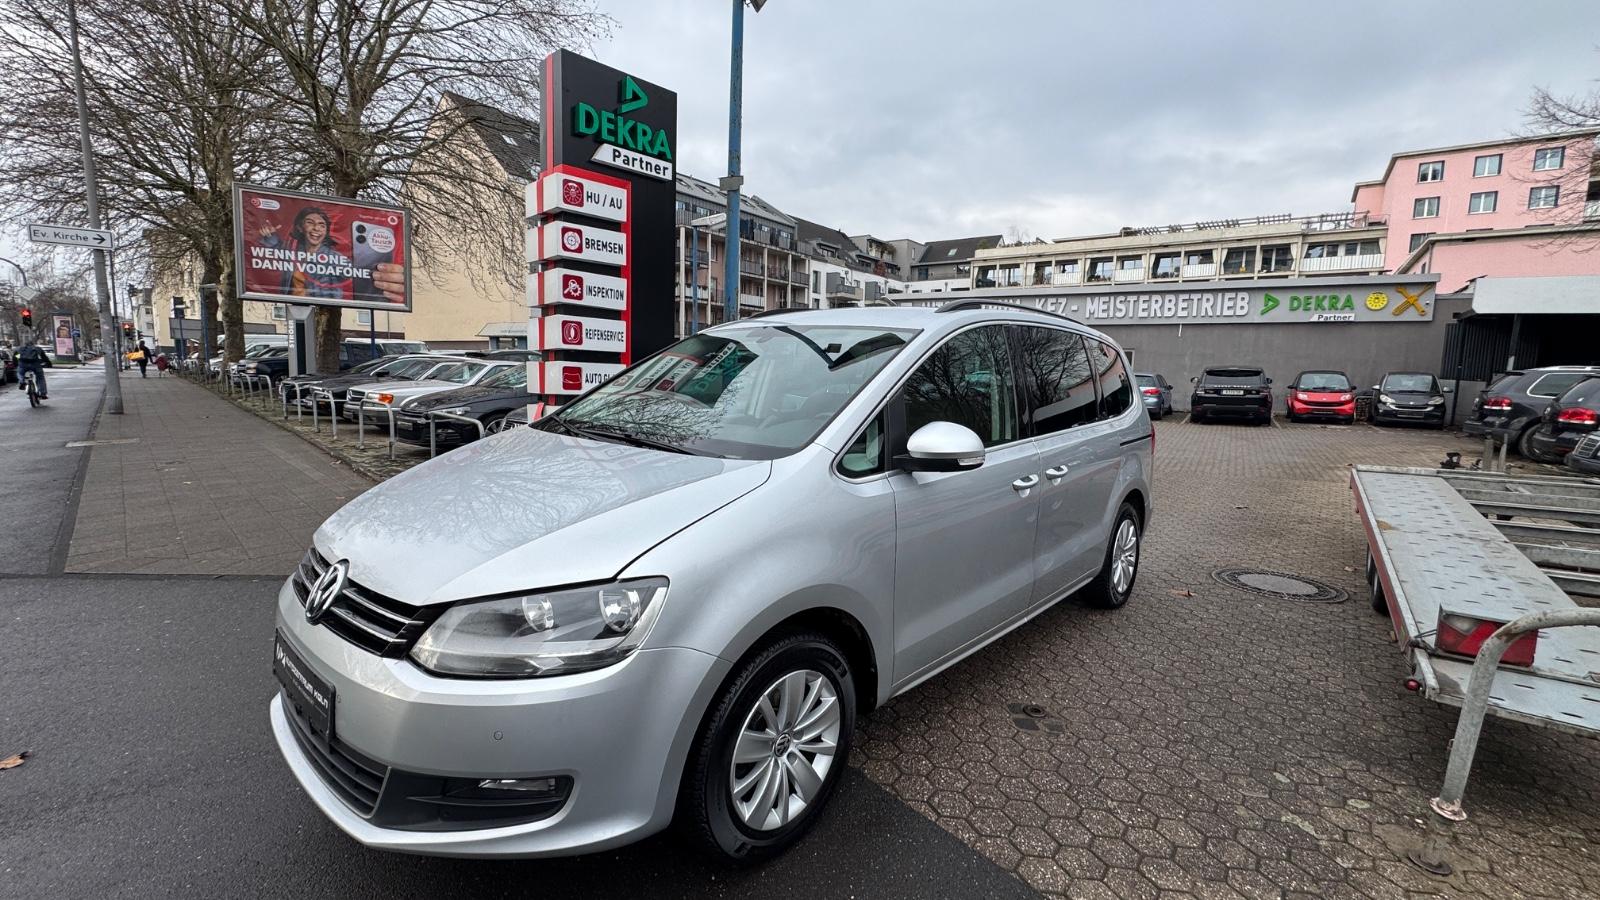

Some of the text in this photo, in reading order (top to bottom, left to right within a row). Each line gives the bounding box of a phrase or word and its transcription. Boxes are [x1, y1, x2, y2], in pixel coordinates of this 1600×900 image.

[576, 102, 672, 160] DEKRA
[612, 149, 669, 176] Partner
[586, 191, 600, 205] HU
[609, 197, 623, 210] AU
[33, 229, 89, 242] Ev. Kirche
[585, 237, 624, 255] BREMSEN
[250, 246, 353, 267] WENN PHONE,
[252, 258, 371, 279] DANN VODAFONE
[585, 285, 624, 301] INSPEKTION
[1085, 291, 1250, 319] MEISTERBETRIEB
[1288, 294, 1355, 312] DEKRA
[585, 328, 624, 342] REIFENSERVICE
[585, 373, 602, 384] AUTO
